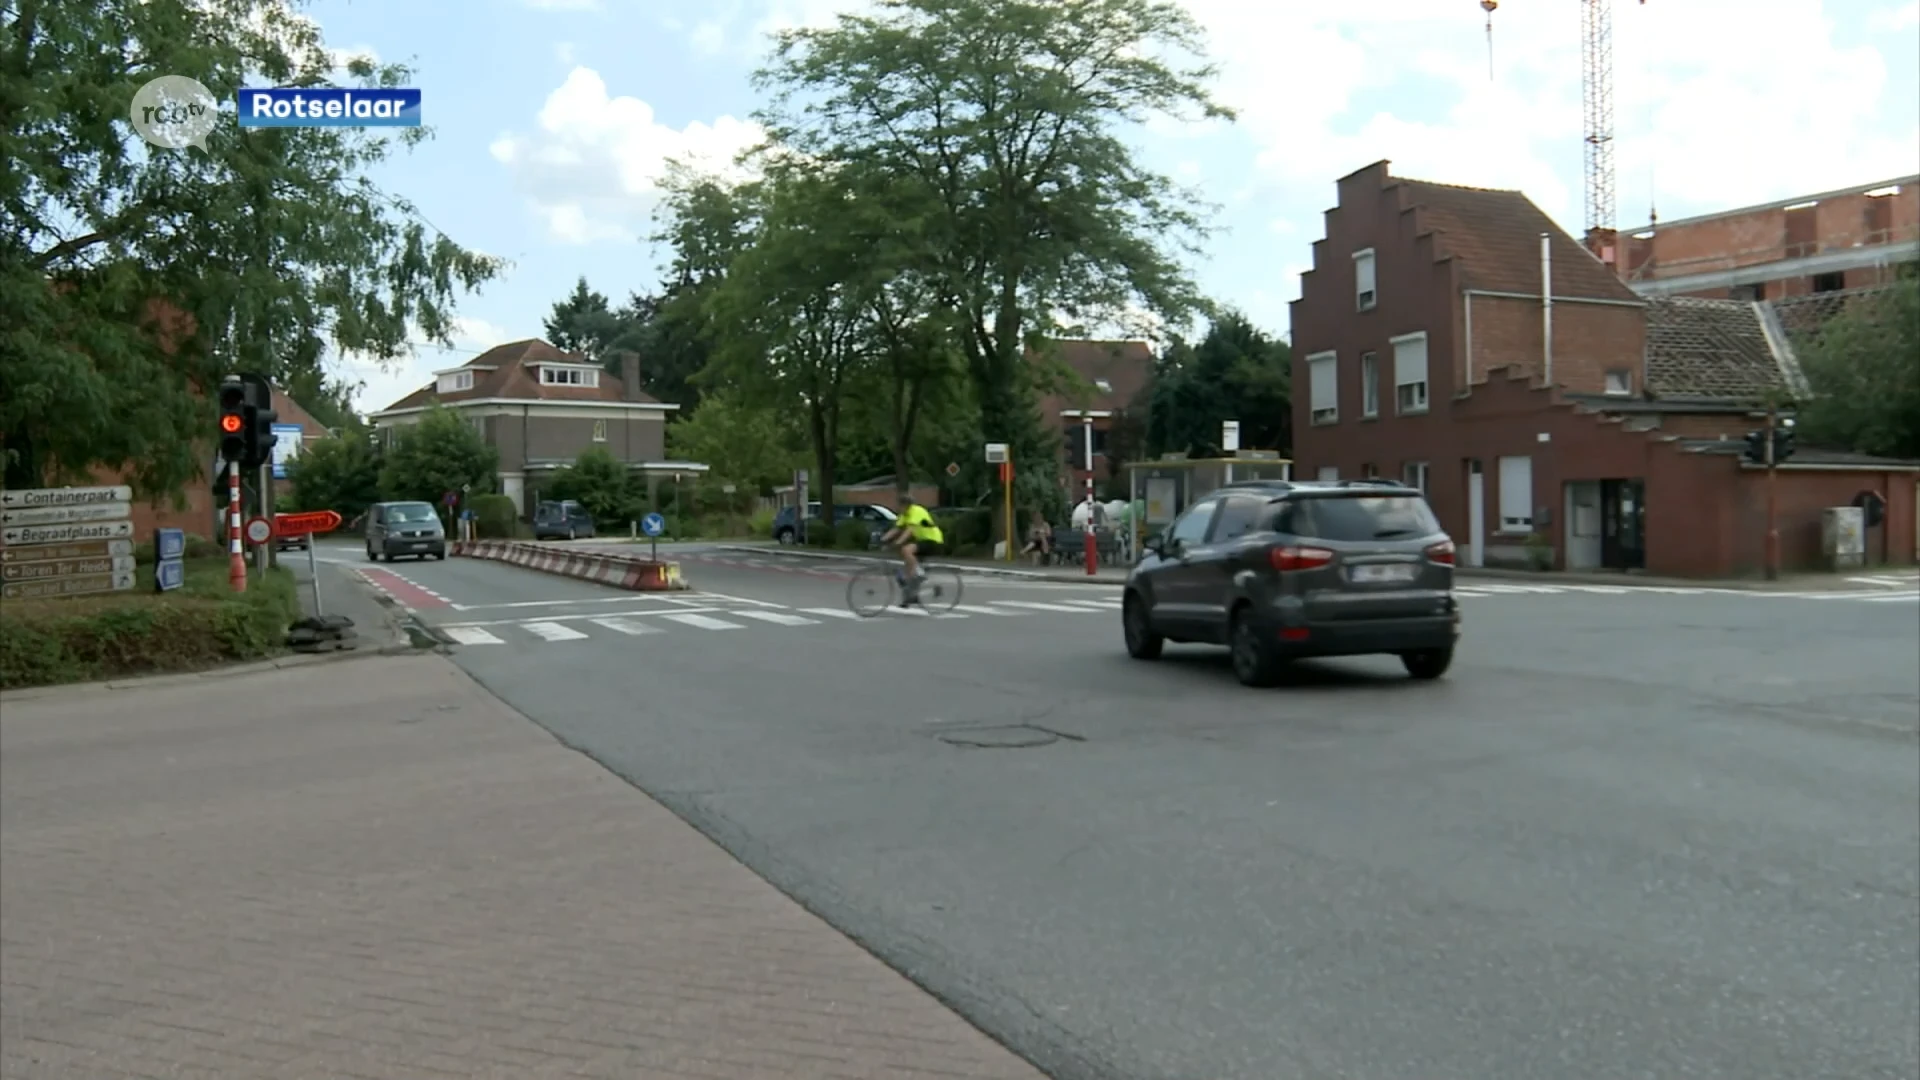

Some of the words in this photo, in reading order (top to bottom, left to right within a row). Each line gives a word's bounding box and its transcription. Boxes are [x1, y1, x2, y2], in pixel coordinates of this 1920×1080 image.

[25, 490, 117, 505] Containerpark
[22, 525, 111, 542] Begraafplaats
[21, 564, 53, 577] Toren
[56, 562, 73, 574] Ter
[79, 560, 110, 573] Heide
